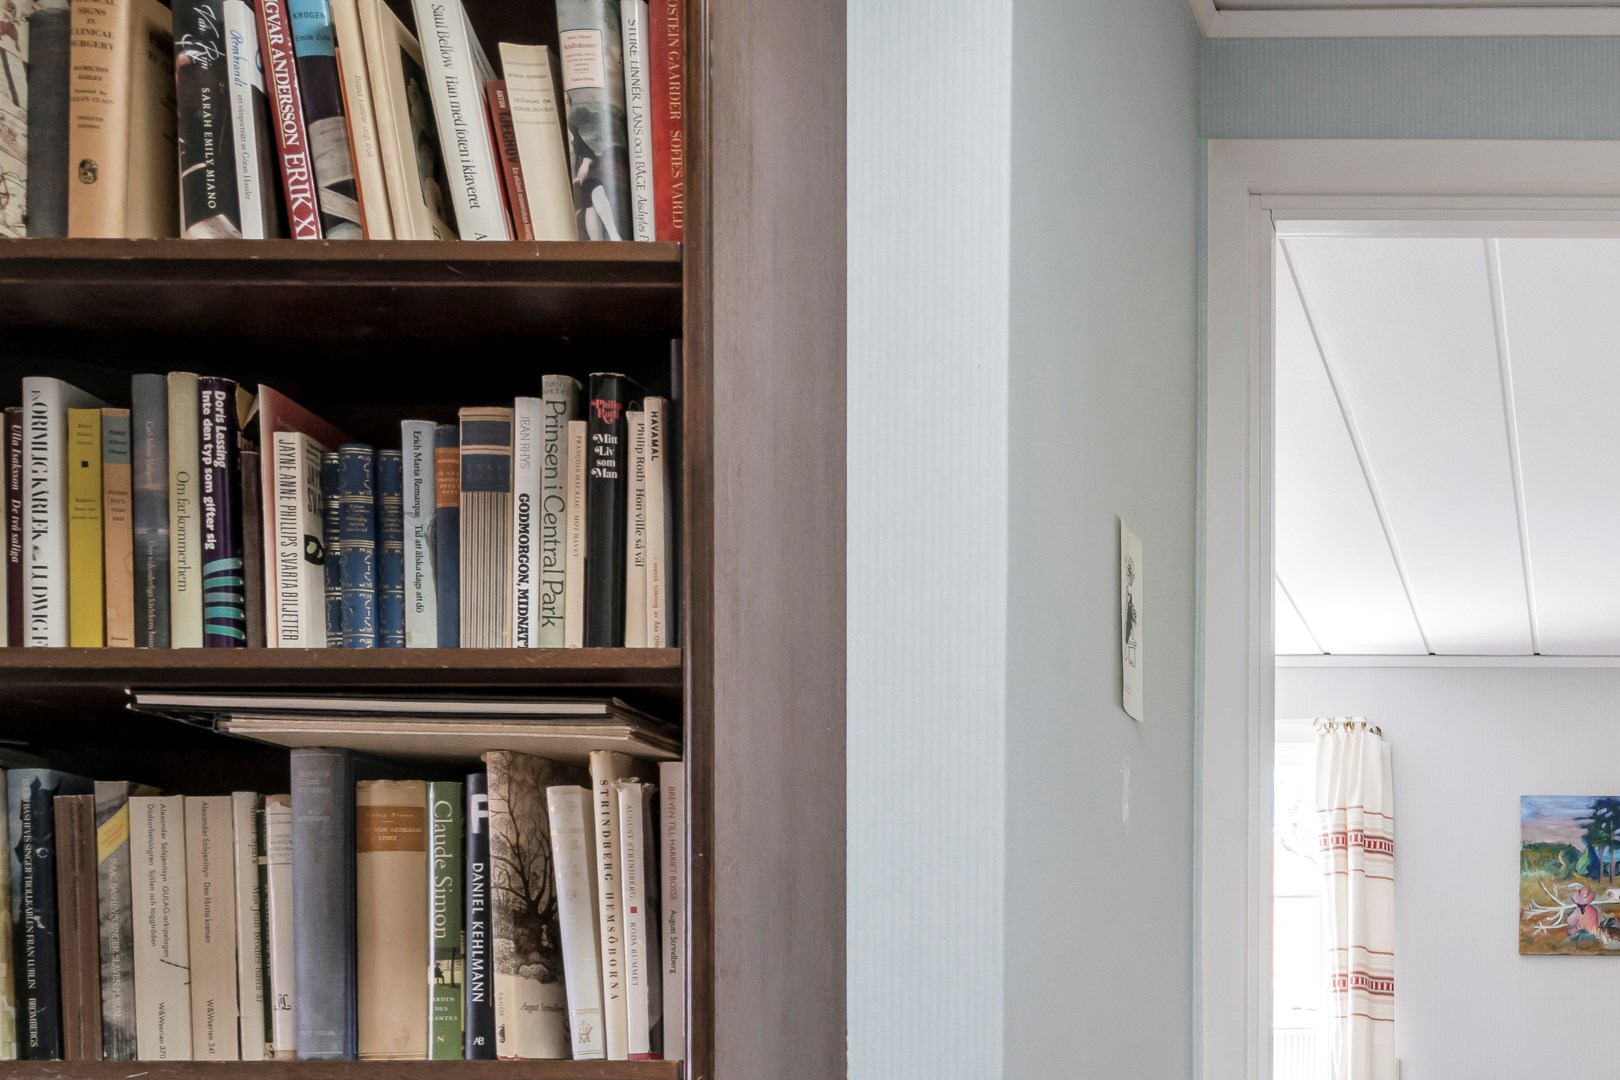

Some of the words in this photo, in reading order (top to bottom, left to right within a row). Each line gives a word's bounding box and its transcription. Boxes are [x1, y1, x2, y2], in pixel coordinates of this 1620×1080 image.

[78, 7, 106, 15] SIGNS
[431, 4, 450, 28] Saul
[230, 30, 248, 87] Rembrandt
[436, 31, 454, 70] Bellow
[445, 76, 458, 98] Han
[201, 87, 212, 128] SARAH
[450, 101, 463, 126] med
[238, 105, 247, 143] vänporträtt
[204, 132, 214, 166] EMILY
[455, 128, 470, 157] foten
[241, 153, 250, 174] Göran
[206, 169, 216, 209] MIANO
[243, 176, 253, 200] Hassler
[463, 166, 480, 209] klaveret
[202, 391, 212, 415] Inte
[215, 391, 226, 423] Doris
[11, 424, 22, 446] Ulla
[204, 419, 213, 440] den
[413, 431, 421, 450] Erich
[520, 415, 530, 440] JEAN
[544, 400, 567, 479] Prinsen
[593, 434, 618, 444] Mitt
[635, 423, 645, 453] Philip
[201, 444, 213, 464] typ
[213, 426, 227, 468] Lessing
[279, 439, 296, 471] JAYNE
[520, 444, 530, 469] RHYS
[595, 446, 614, 455] Liv
[10, 448, 21, 490] Isaksson
[413, 452, 421, 476] Maria
[591, 468, 618, 479] Man
[636, 457, 644, 482] Roth
[177, 471, 190, 495] Om
[205, 468, 213, 494] som
[280, 474, 296, 500] ANNE
[11, 499, 21, 512] De
[177, 498, 191, 513] far
[411, 478, 422, 518] Remarque
[636, 488, 644, 511] Hon
[10, 515, 22, 531] två
[204, 496, 216, 530] gifter
[281, 505, 297, 547] PHILLIPS
[636, 514, 644, 535] ville
[178, 515, 191, 565] kommer
[205, 534, 216, 550] sig
[415, 524, 424, 537] Tid
[517, 493, 529, 585] GODMORGON,
[543, 494, 565, 574] Central
[636, 538, 645, 549] så
[10, 534, 21, 562] saliga
[415, 540, 423, 549] att
[281, 552, 297, 588] SVARTA
[415, 551, 424, 571] älska
[635, 552, 645, 567] väl
[178, 566, 191, 592] hem
[413, 572, 424, 589] dags
[416, 591, 424, 601] att
[416, 602, 424, 613] dö
[542, 580, 564, 628] Park
[282, 592, 299, 640] BILJETTER
[668, 786, 676, 819] BREVEN
[202, 801, 210, 837] Alexander
[599, 780, 613, 881] STRINDBERG
[668, 822, 676, 837] TILL
[147, 804, 156, 865] Dödsarbetslägren
[434, 800, 453, 869] Claude
[201, 839, 210, 878] Solsjenitsyn
[668, 839, 677, 874] HARRIET
[147, 870, 157, 891] Själen
[203, 882, 211, 896] Den
[472, 862, 484, 914] DANIEL
[669, 876, 677, 901] BOSSE
[149, 894, 157, 906] och
[203, 897, 212, 917] första
[434, 876, 453, 939] Simon
[150, 908, 158, 947] taggtråden
[204, 919, 212, 943] kretsen
[668, 909, 677, 935] August
[605, 892, 619, 1000] HEMSÖBORNA
[668, 936, 678, 974] Strindberg
[472, 921, 484, 1003] KEHLMANN
